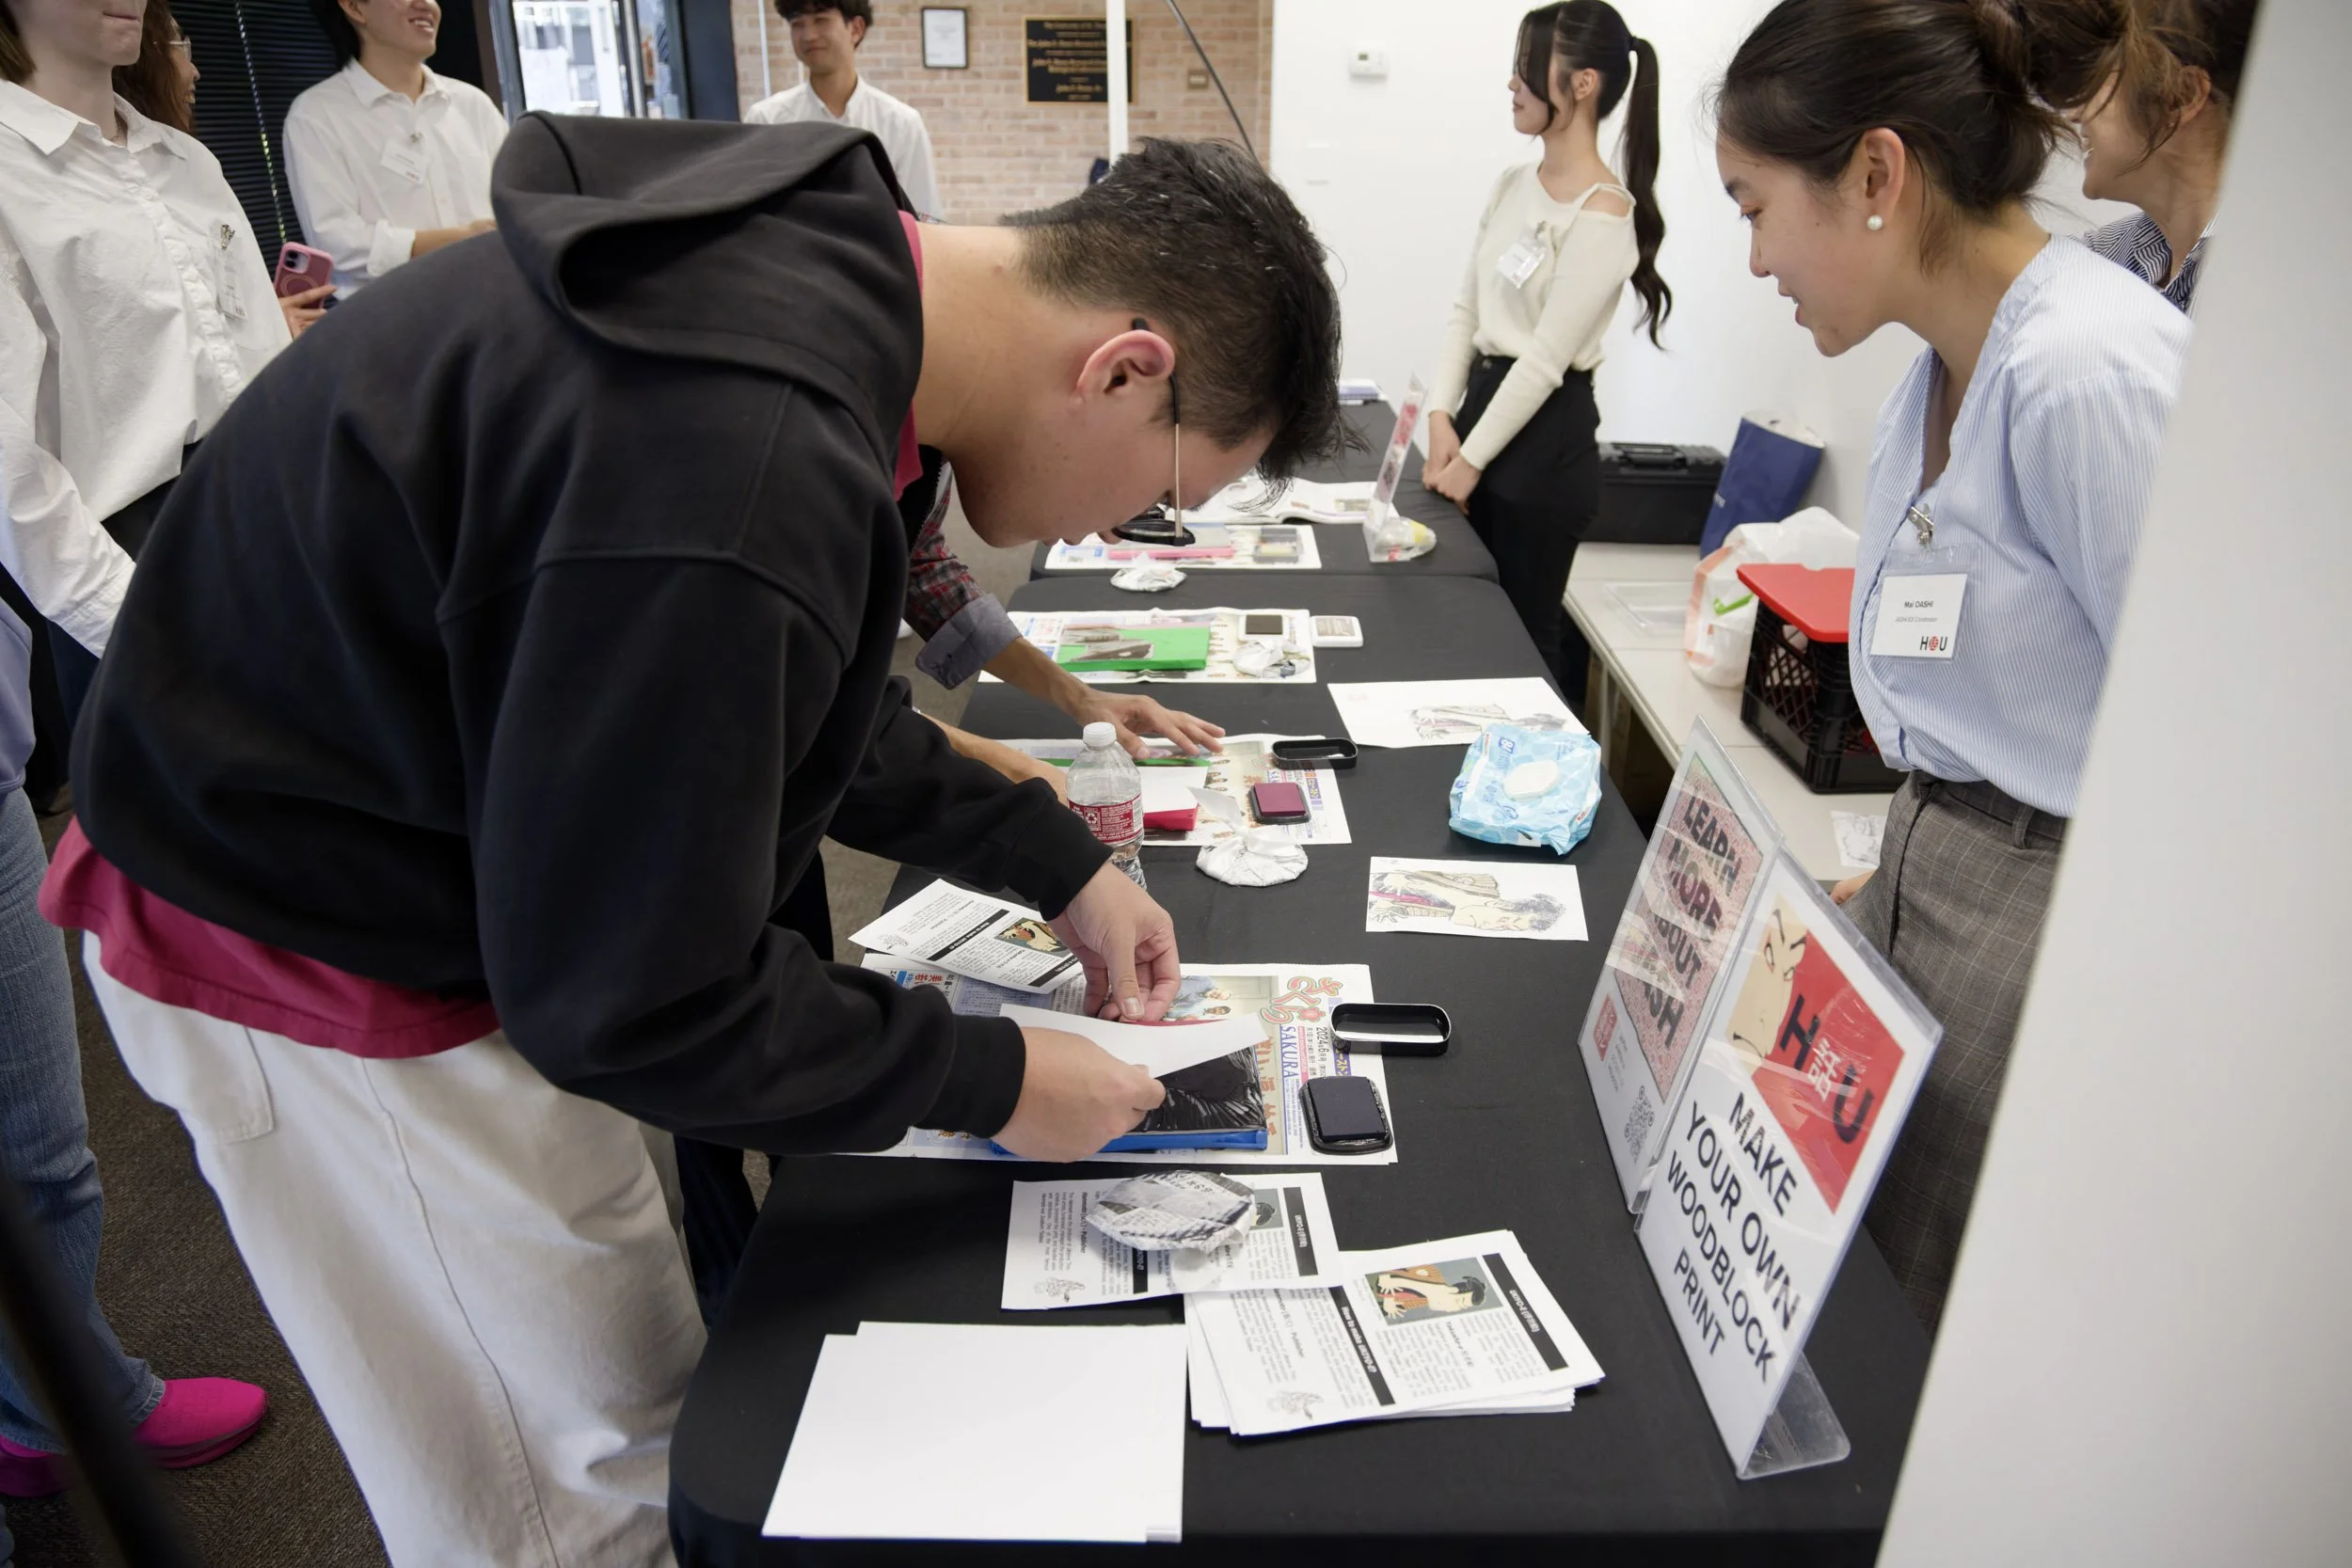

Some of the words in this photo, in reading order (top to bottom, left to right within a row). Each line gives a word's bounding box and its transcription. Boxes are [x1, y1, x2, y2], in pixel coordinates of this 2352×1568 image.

[1260, 975, 1343, 1024] さくら
[1280, 1025, 1299, 1078] SAKURA
[1728, 1091, 1799, 1218] MAKE
[1685, 1101, 1746, 1224] YOUR
[1740, 1212, 1802, 1332] OWN
[1666, 1149, 1778, 1386] WOODBLOCK
[1342, 1307, 1352, 1321] How
[1347, 1320, 1355, 1328] to
[1674, 1246, 1727, 1357] PRINT
[1350, 1327, 1362, 1344] make
